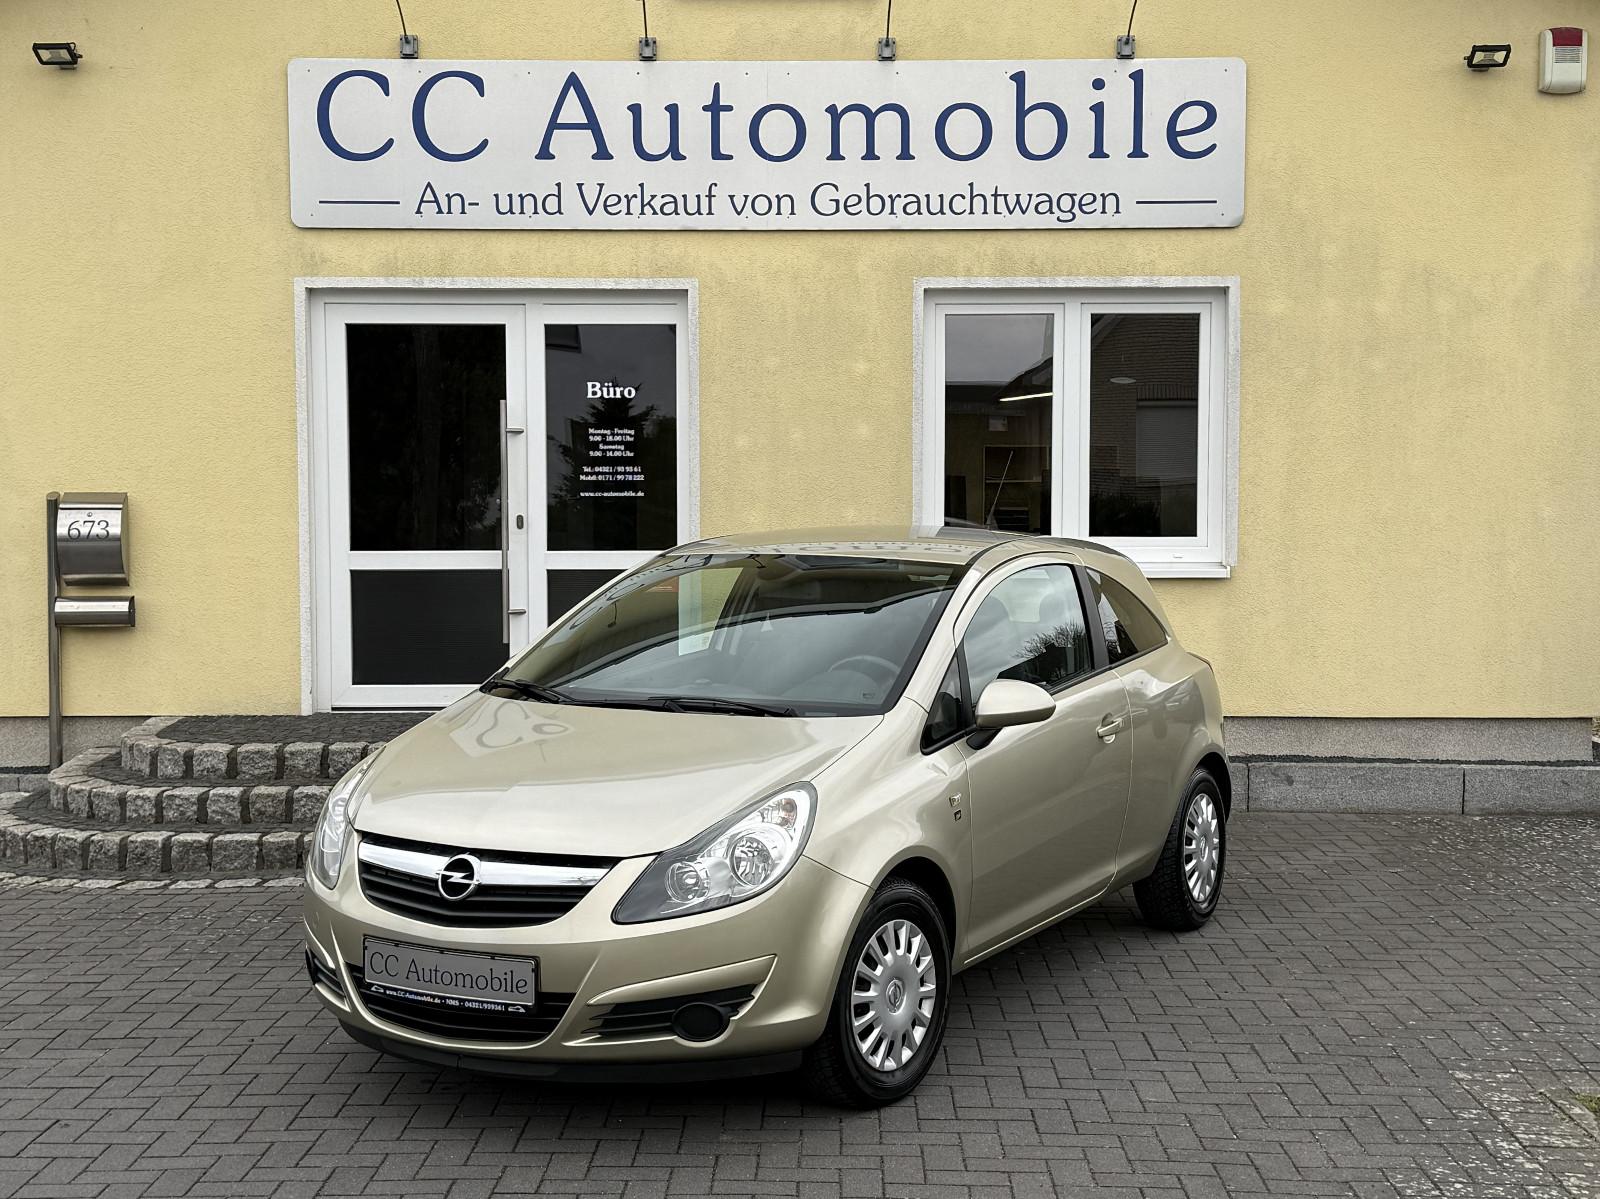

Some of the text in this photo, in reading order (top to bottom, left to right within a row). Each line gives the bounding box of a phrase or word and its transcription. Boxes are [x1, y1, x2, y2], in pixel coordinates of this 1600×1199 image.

[317, 69, 1217, 162] CC Automobile
[415, 182, 1121, 223] An- und Verkauf von Gebrauchtwagen
[586, 381, 636, 399] Büro
[588, 428, 611, 436] Montag
[614, 428, 635, 436] Freitag
[599, 443, 625, 451] Samstag
[67, 519, 110, 541] 673
[369, 951, 528, 994] CC Automobile
